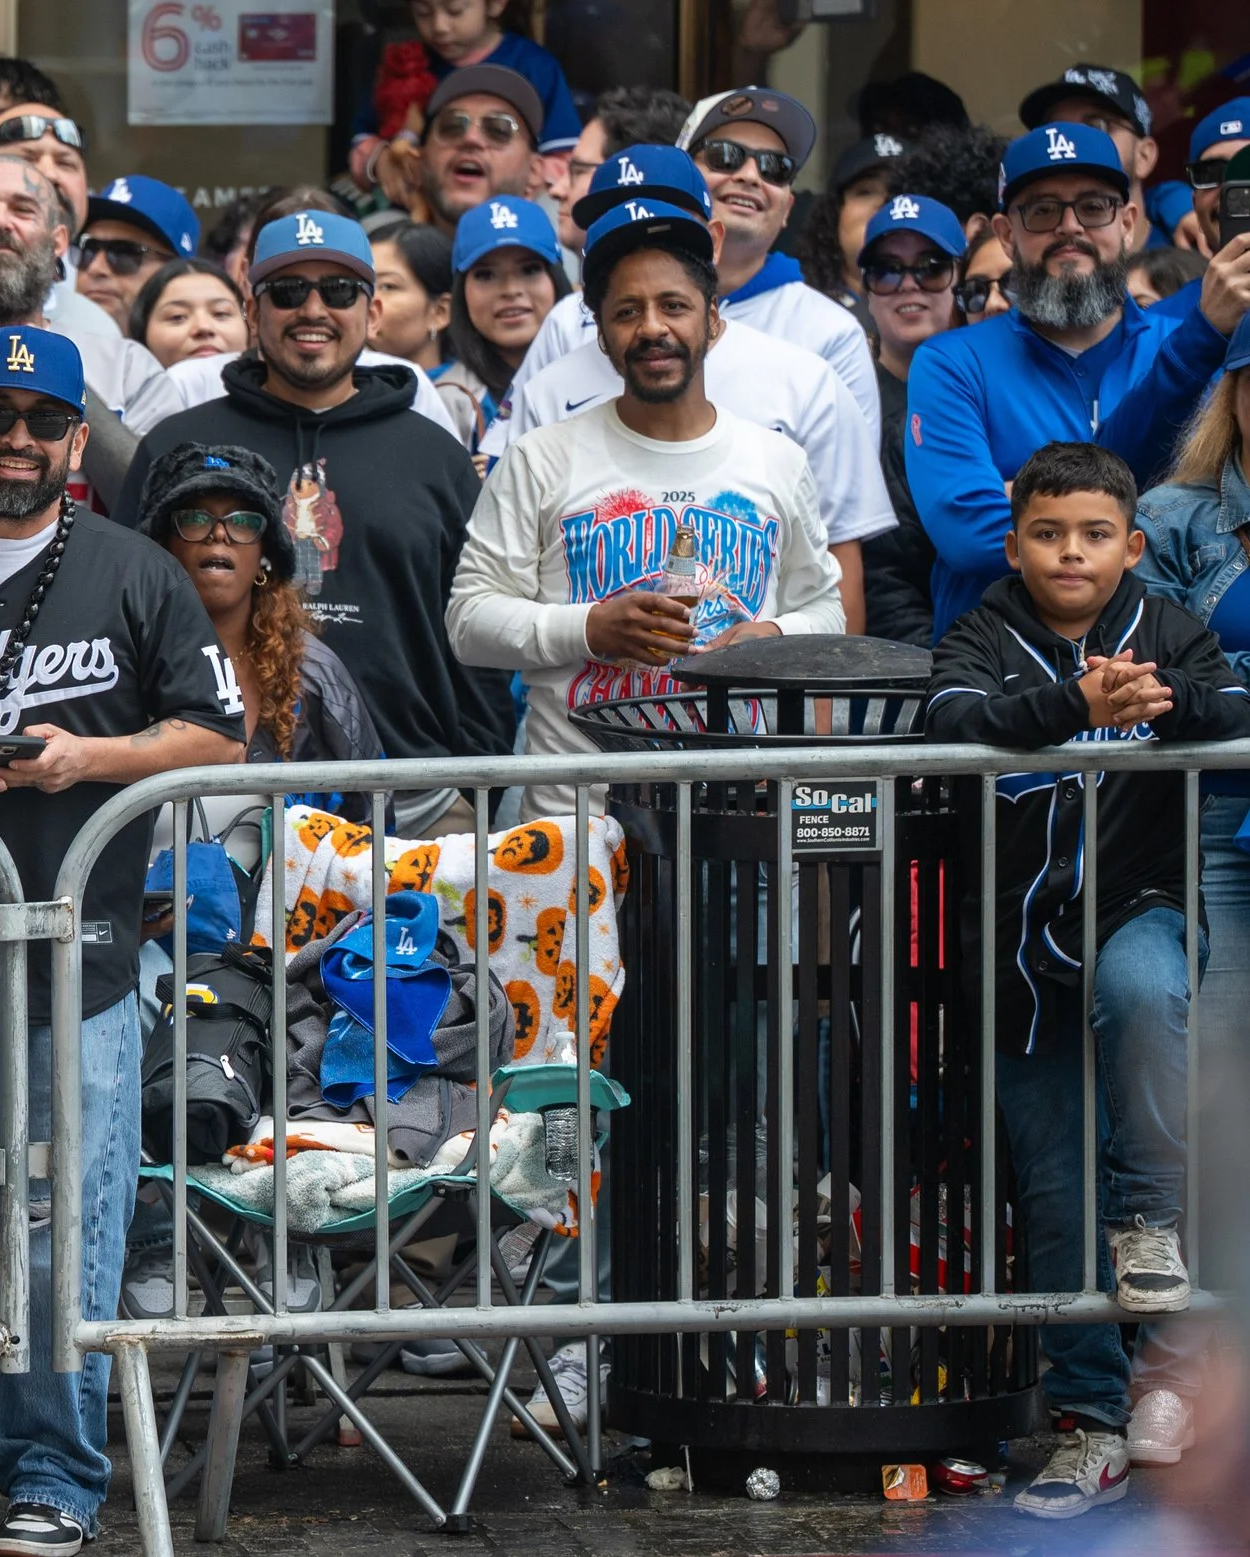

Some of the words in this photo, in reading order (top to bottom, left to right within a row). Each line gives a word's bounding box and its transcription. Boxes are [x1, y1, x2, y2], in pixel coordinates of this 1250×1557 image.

[874, 133, 903, 157] LA
[1045, 128, 1077, 161] LA
[617, 156, 645, 186] LA
[489, 202, 518, 229] LA
[889, 194, 920, 220] LA
[295, 213, 324, 245] LA
[6, 335, 35, 373] LA
[662, 491, 696, 503] 2025
[558, 504, 682, 606] WORLD
[302, 602, 328, 611] RALPH
[329, 604, 360, 613] LAUREN
[200, 644, 246, 715] LA
[795, 786, 872, 814] SoCal
[796, 826, 870, 838] 800-850-8871
[799, 815, 829, 824] FENCE
[395, 926, 418, 955] LA
